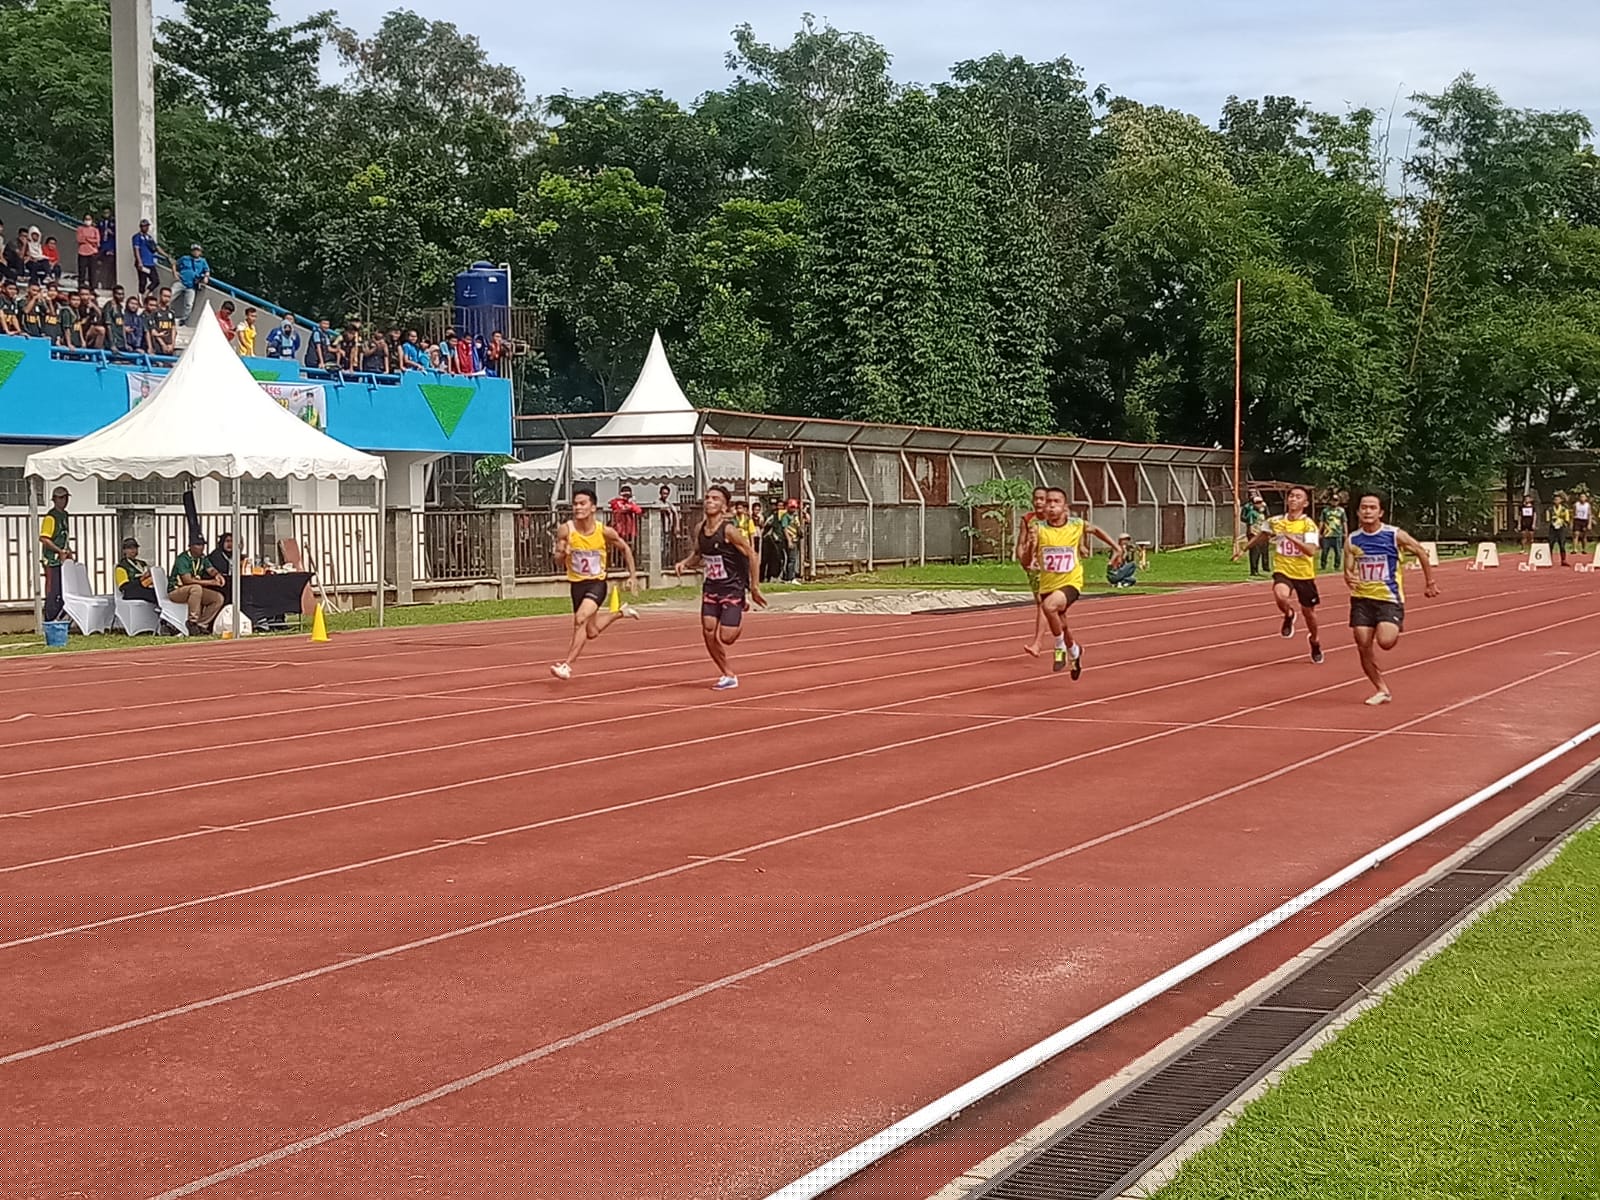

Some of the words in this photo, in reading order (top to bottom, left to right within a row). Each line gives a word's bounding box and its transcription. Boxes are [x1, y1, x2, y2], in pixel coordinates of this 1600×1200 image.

[1483, 549, 1490, 560] 7
[1534, 549, 1543, 560] 6
[580, 558, 590, 573] 2
[1046, 554, 1072, 571] 277
[1361, 563, 1385, 580] 177
